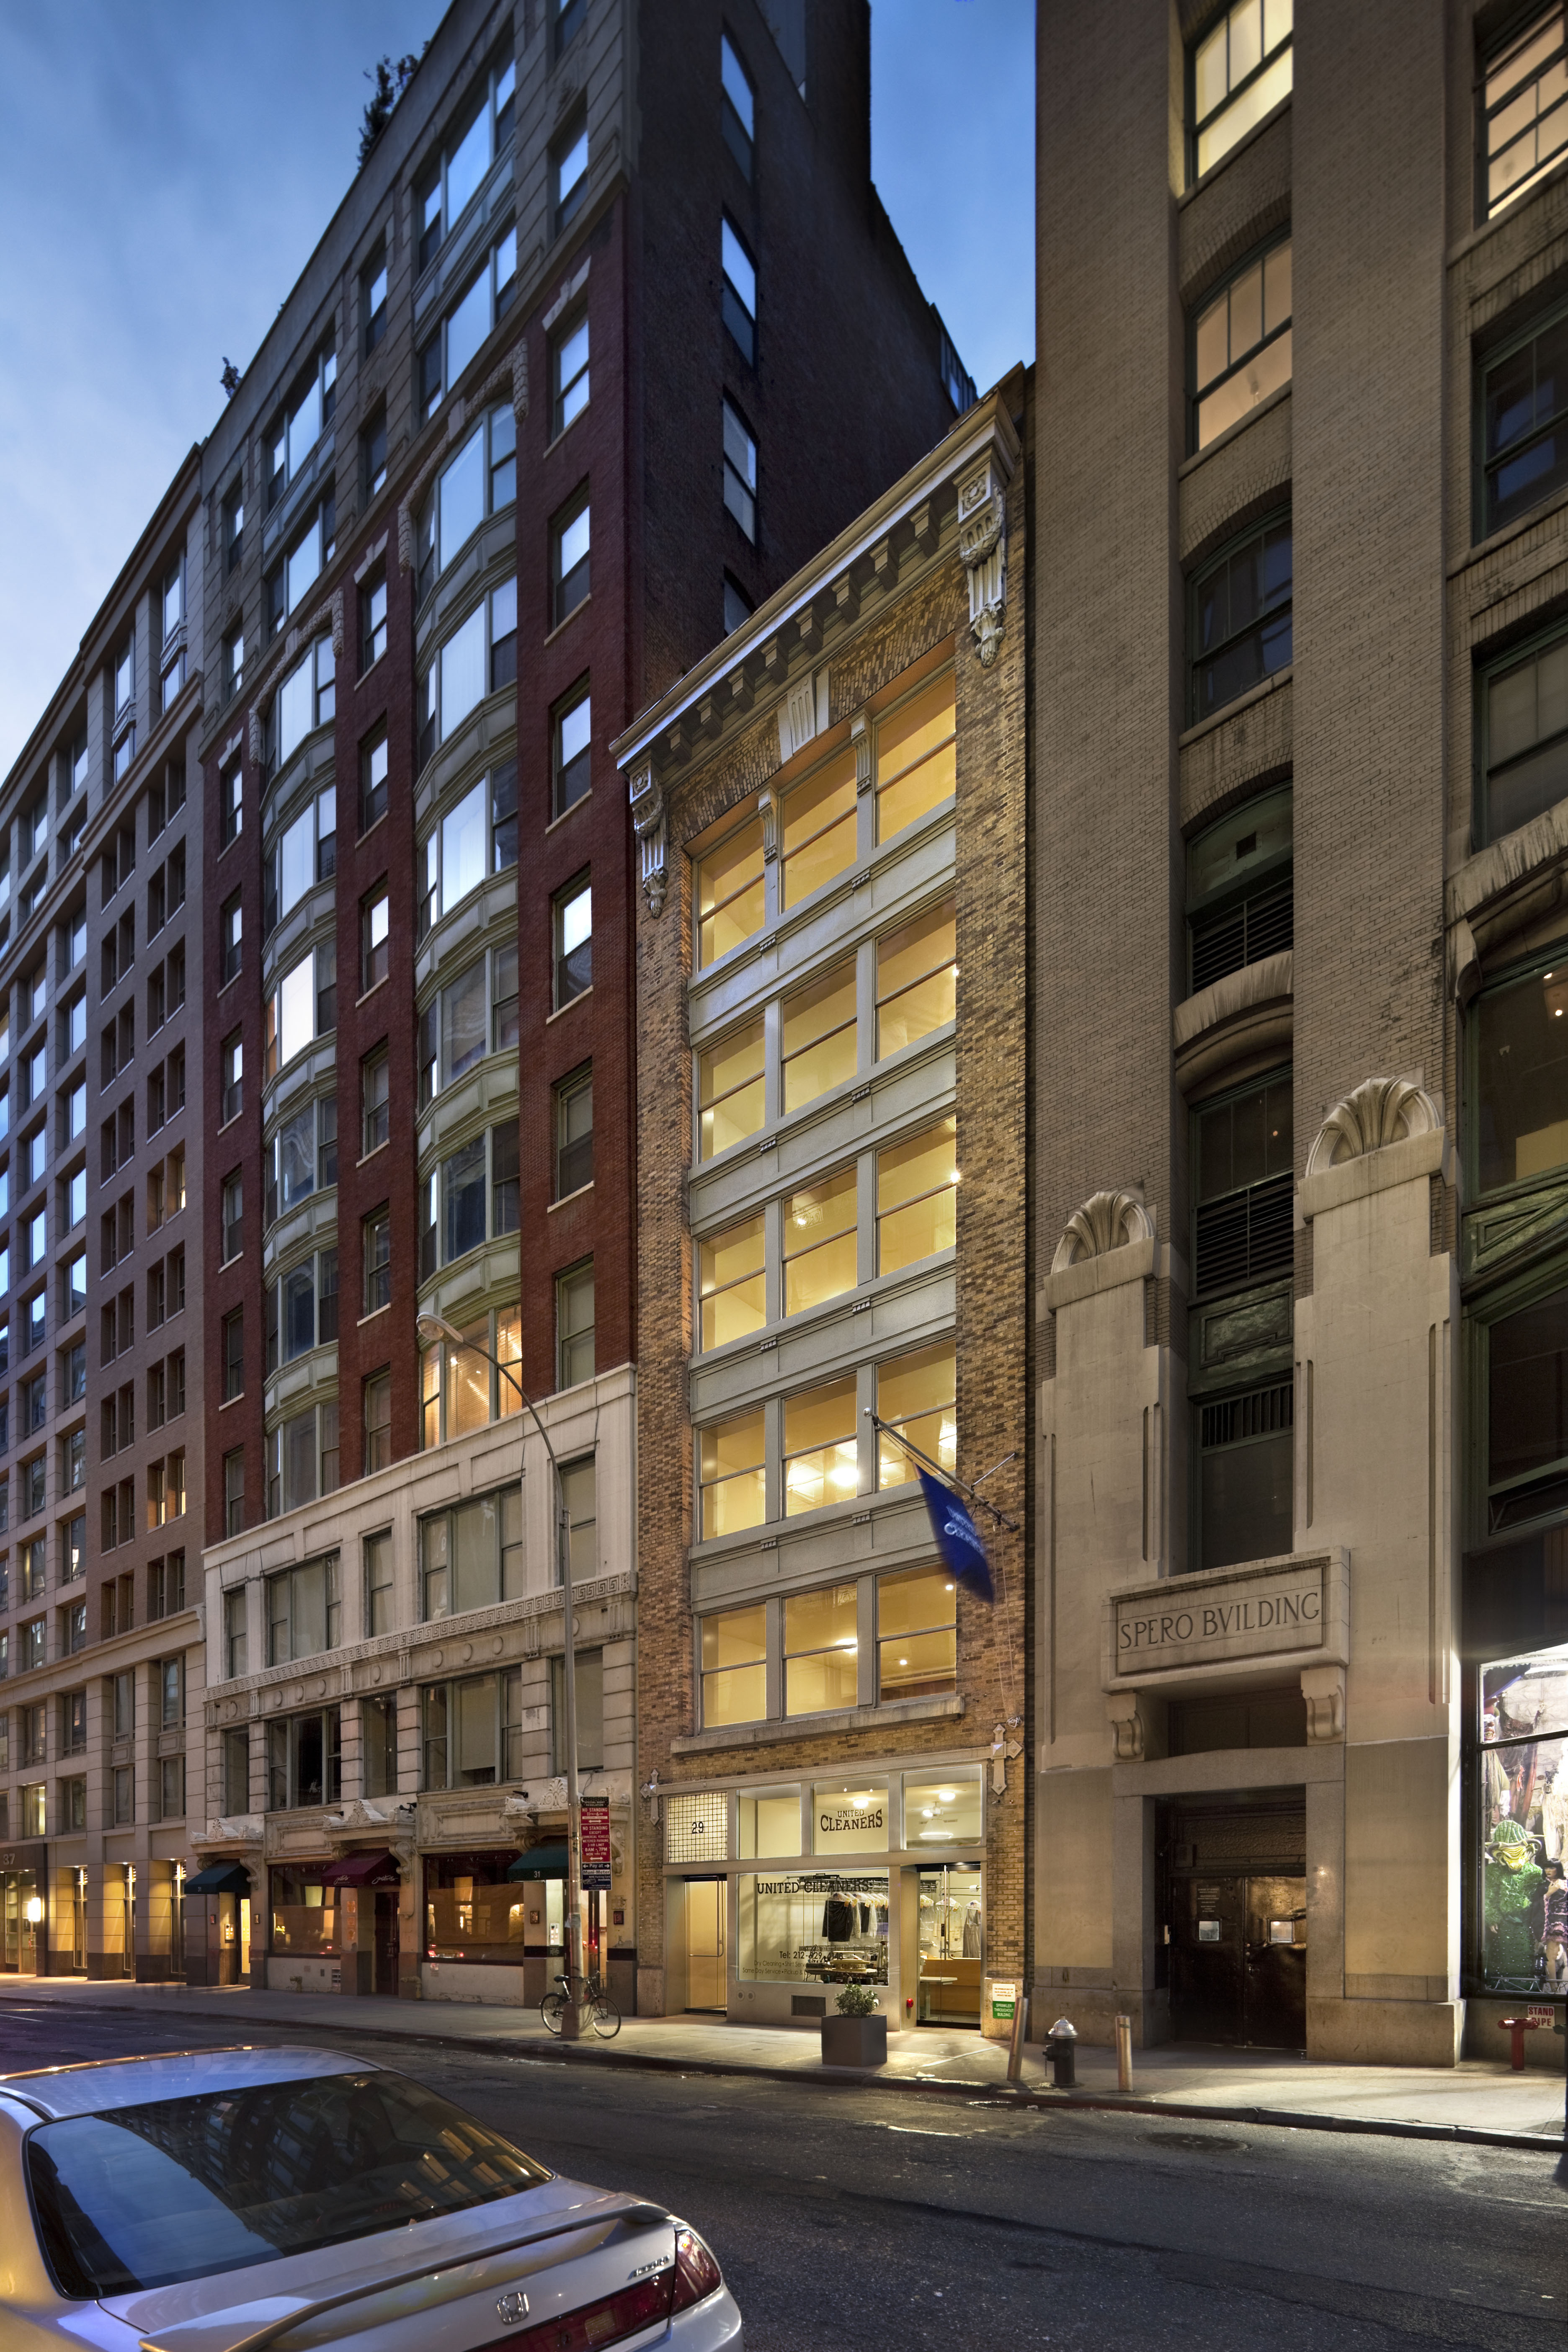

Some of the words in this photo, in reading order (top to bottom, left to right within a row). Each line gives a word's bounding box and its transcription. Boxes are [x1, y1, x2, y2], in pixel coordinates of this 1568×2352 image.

[1119, 1614, 1193, 1649] SPERO
[820, 1808, 882, 1832] CLEANERS
[838, 1809, 864, 1818] UNITED
[692, 1821, 704, 1834] 29
[3, 1853, 15, 1865] 37
[757, 1882, 799, 1894] UNITED
[804, 1880, 869, 1893] CLEANERS
[1528, 2006, 1554, 2016] STAND
